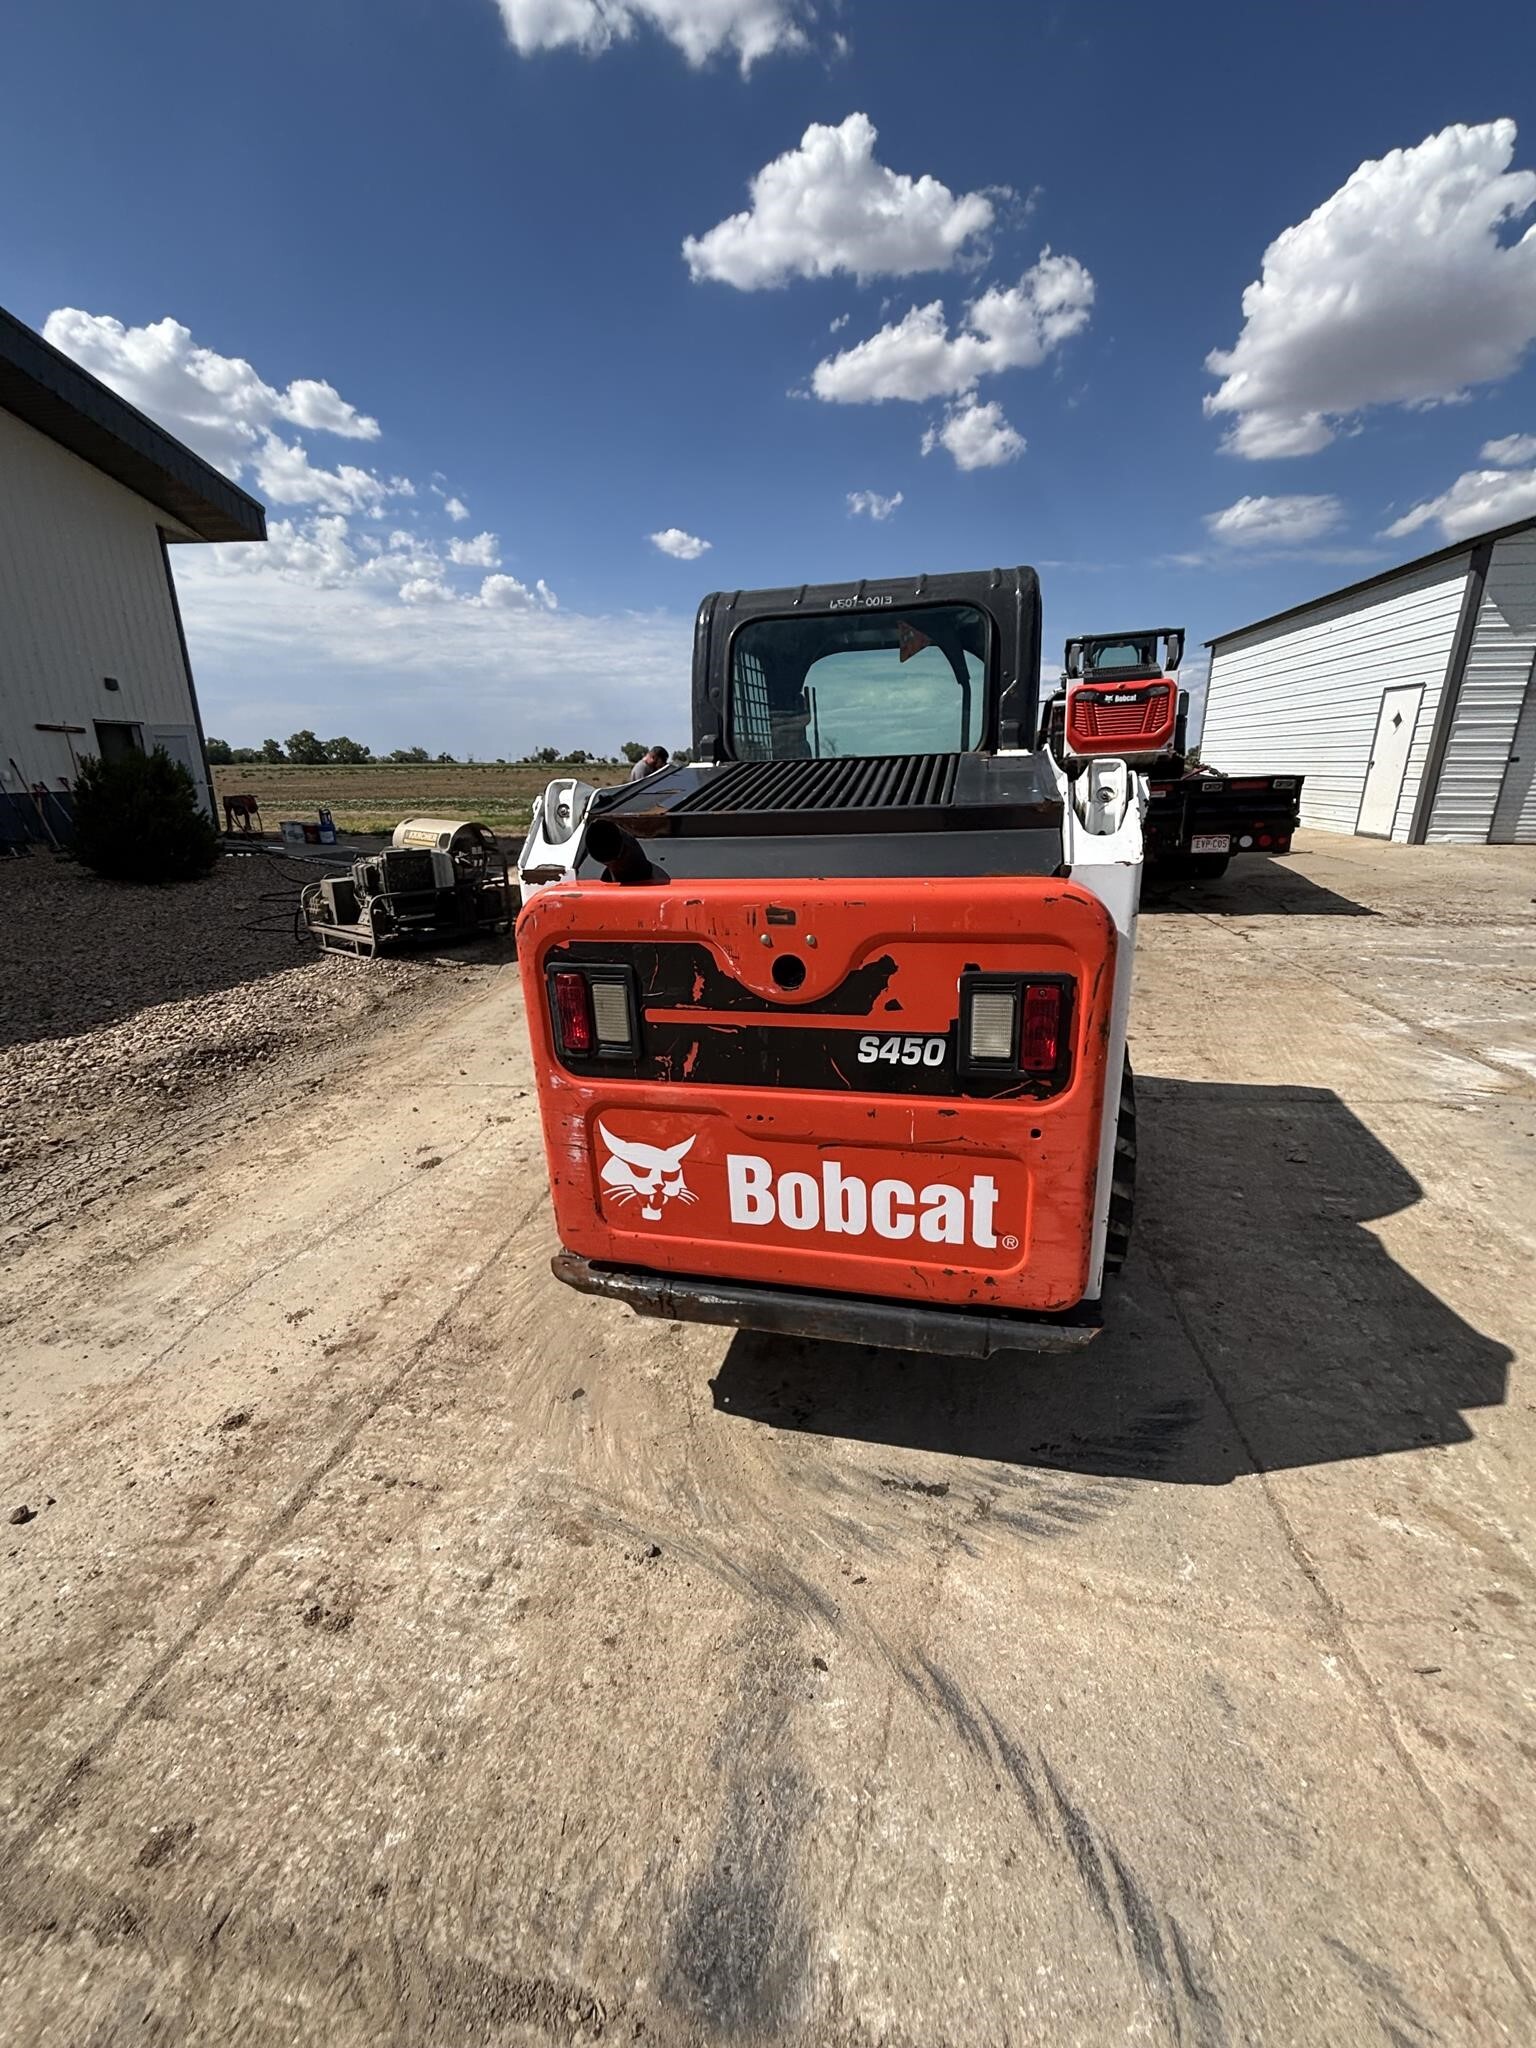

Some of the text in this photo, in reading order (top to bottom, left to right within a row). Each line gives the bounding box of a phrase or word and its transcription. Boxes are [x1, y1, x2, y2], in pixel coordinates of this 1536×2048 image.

[1115, 694, 1137, 702] Bobcat
[857, 1036, 946, 1066] S450
[727, 1154, 998, 1248] Bobcat
